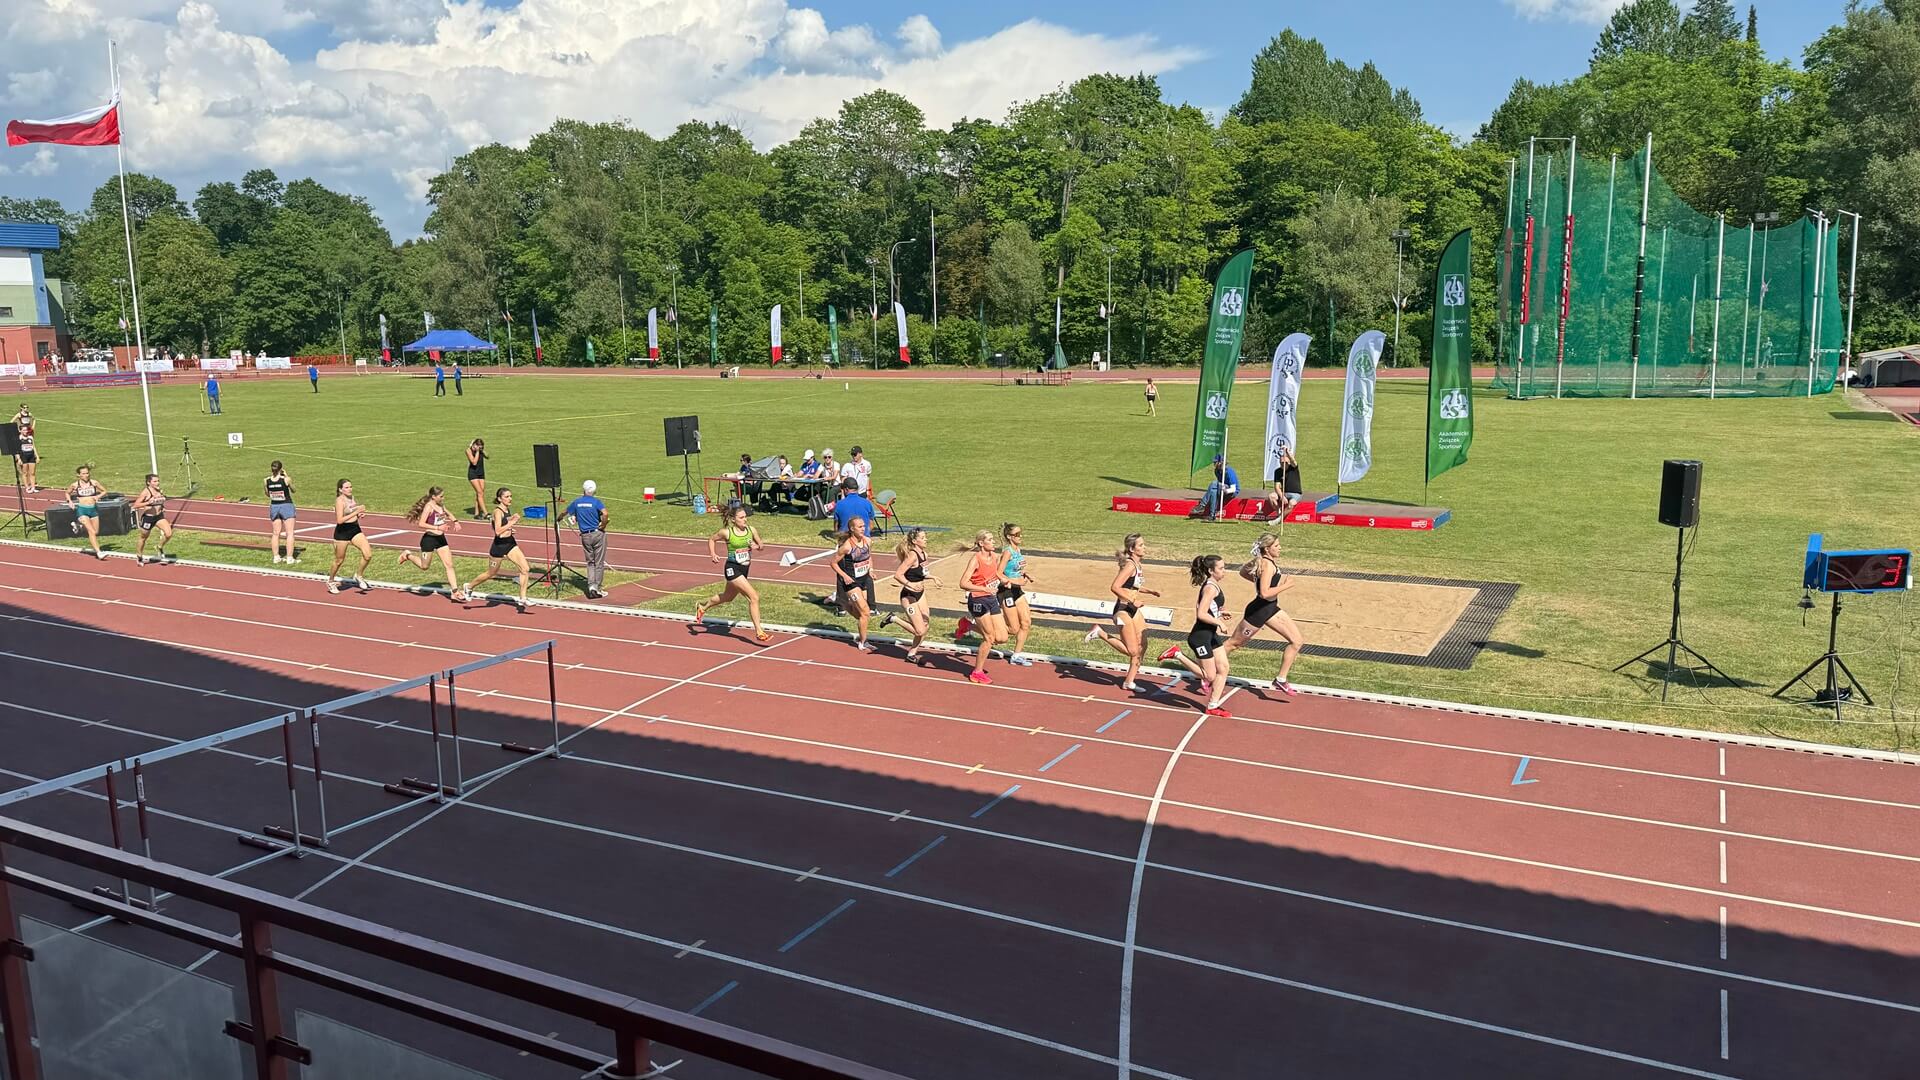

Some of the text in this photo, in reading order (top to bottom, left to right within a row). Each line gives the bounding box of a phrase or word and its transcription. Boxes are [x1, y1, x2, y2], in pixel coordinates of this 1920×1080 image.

[1154, 502, 1162, 512] 2
[1256, 502, 1264, 512] 1
[1368, 518, 1376, 527] 3
[1881, 556, 1904, 586] 3
[1199, 647, 1205, 655] 4
